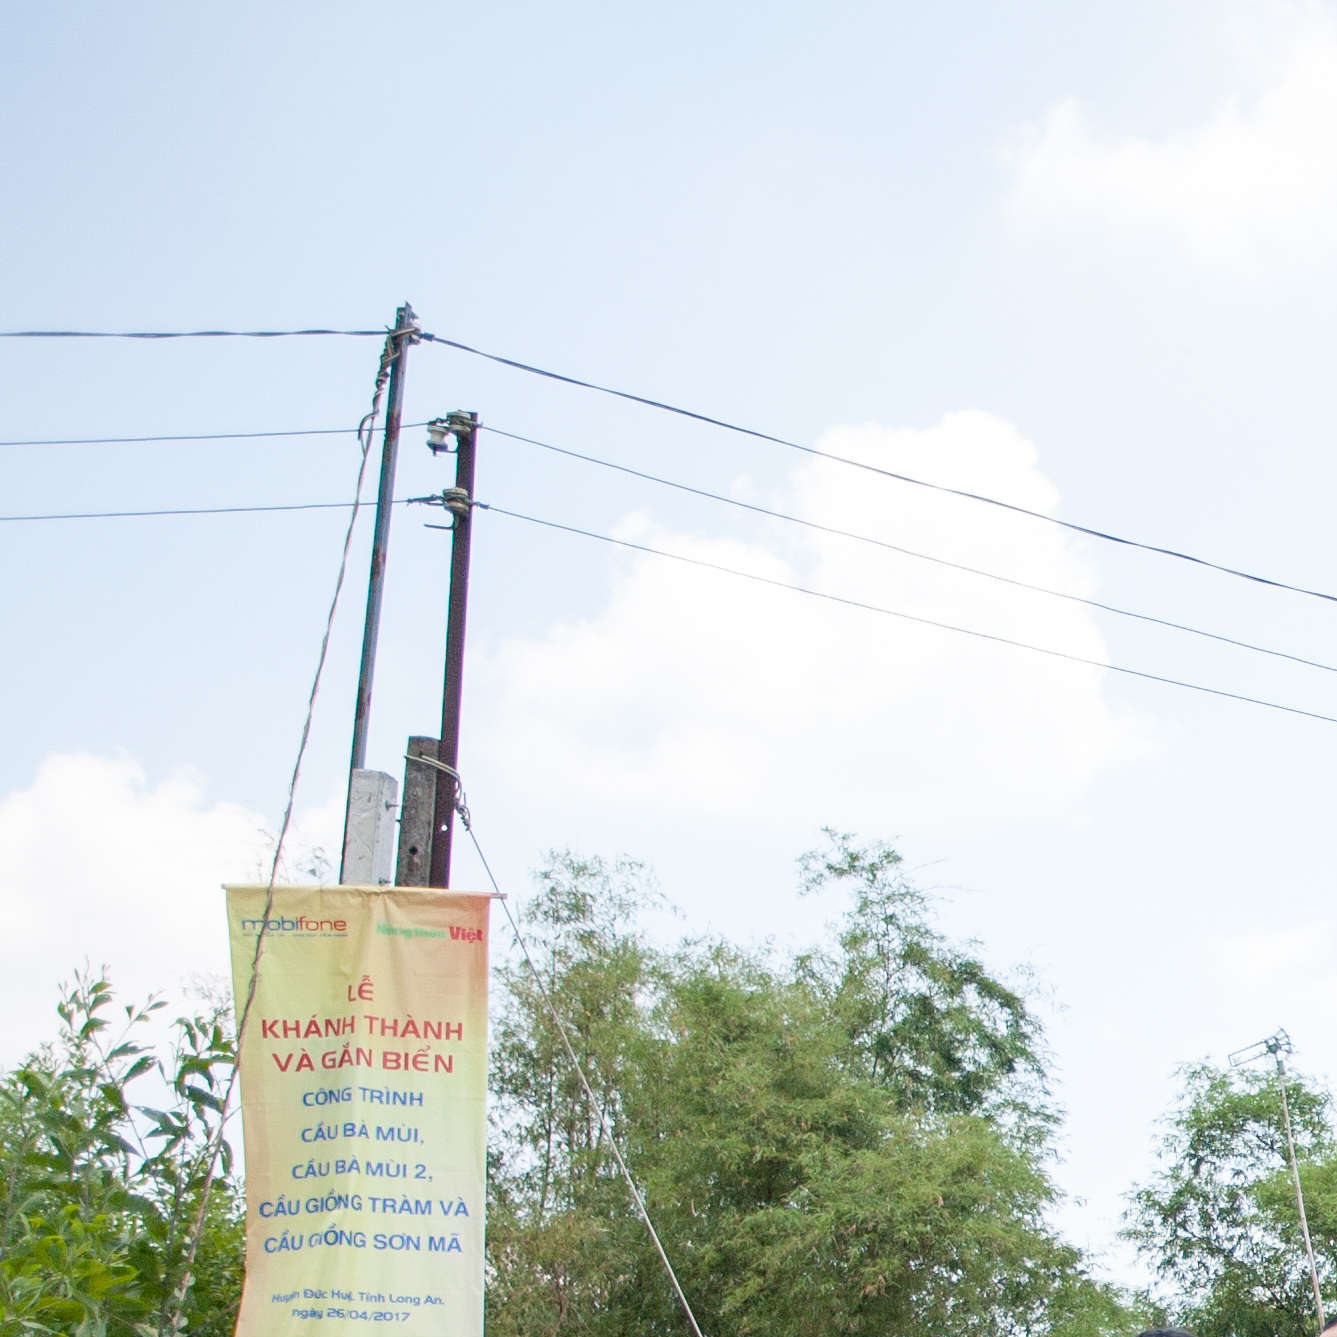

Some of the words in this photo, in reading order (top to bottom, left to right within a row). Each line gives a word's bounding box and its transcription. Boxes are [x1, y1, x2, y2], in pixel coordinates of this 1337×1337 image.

[242, 916, 347, 931] mobifone
[449, 925, 483, 943] Việt
[347, 974, 375, 1002] LỄ
[261, 1014, 356, 1039] KHÁNH
[363, 1014, 463, 1041] THÀNH
[271, 1047, 315, 1073] VÀ
[321, 1042, 373, 1070] GẮN
[382, 1045, 454, 1074] BIỂN
[302, 1086, 353, 1107] CÔNG
[358, 1086, 424, 1107] TRÌNH
[343, 1120, 370, 1139] BÀ
[376, 1123, 425, 1145] MÙI,
[335, 1154, 361, 1175] BÀ
[365, 1158, 407, 1178] MÙI
[413, 1163, 433, 1182] 2,
[305, 1188, 363, 1214] GIỒNG
[367, 1194, 432, 1216] TRÀM
[439, 1196, 470, 1217] VÀ
[373, 1232, 421, 1251] SƠN
[428, 1233, 463, 1253] MÃ
[389, 1293, 421, 1306] Long
[292, 1308, 323, 1320] ngày
[327, 1307, 411, 1322] 26/04/2017
